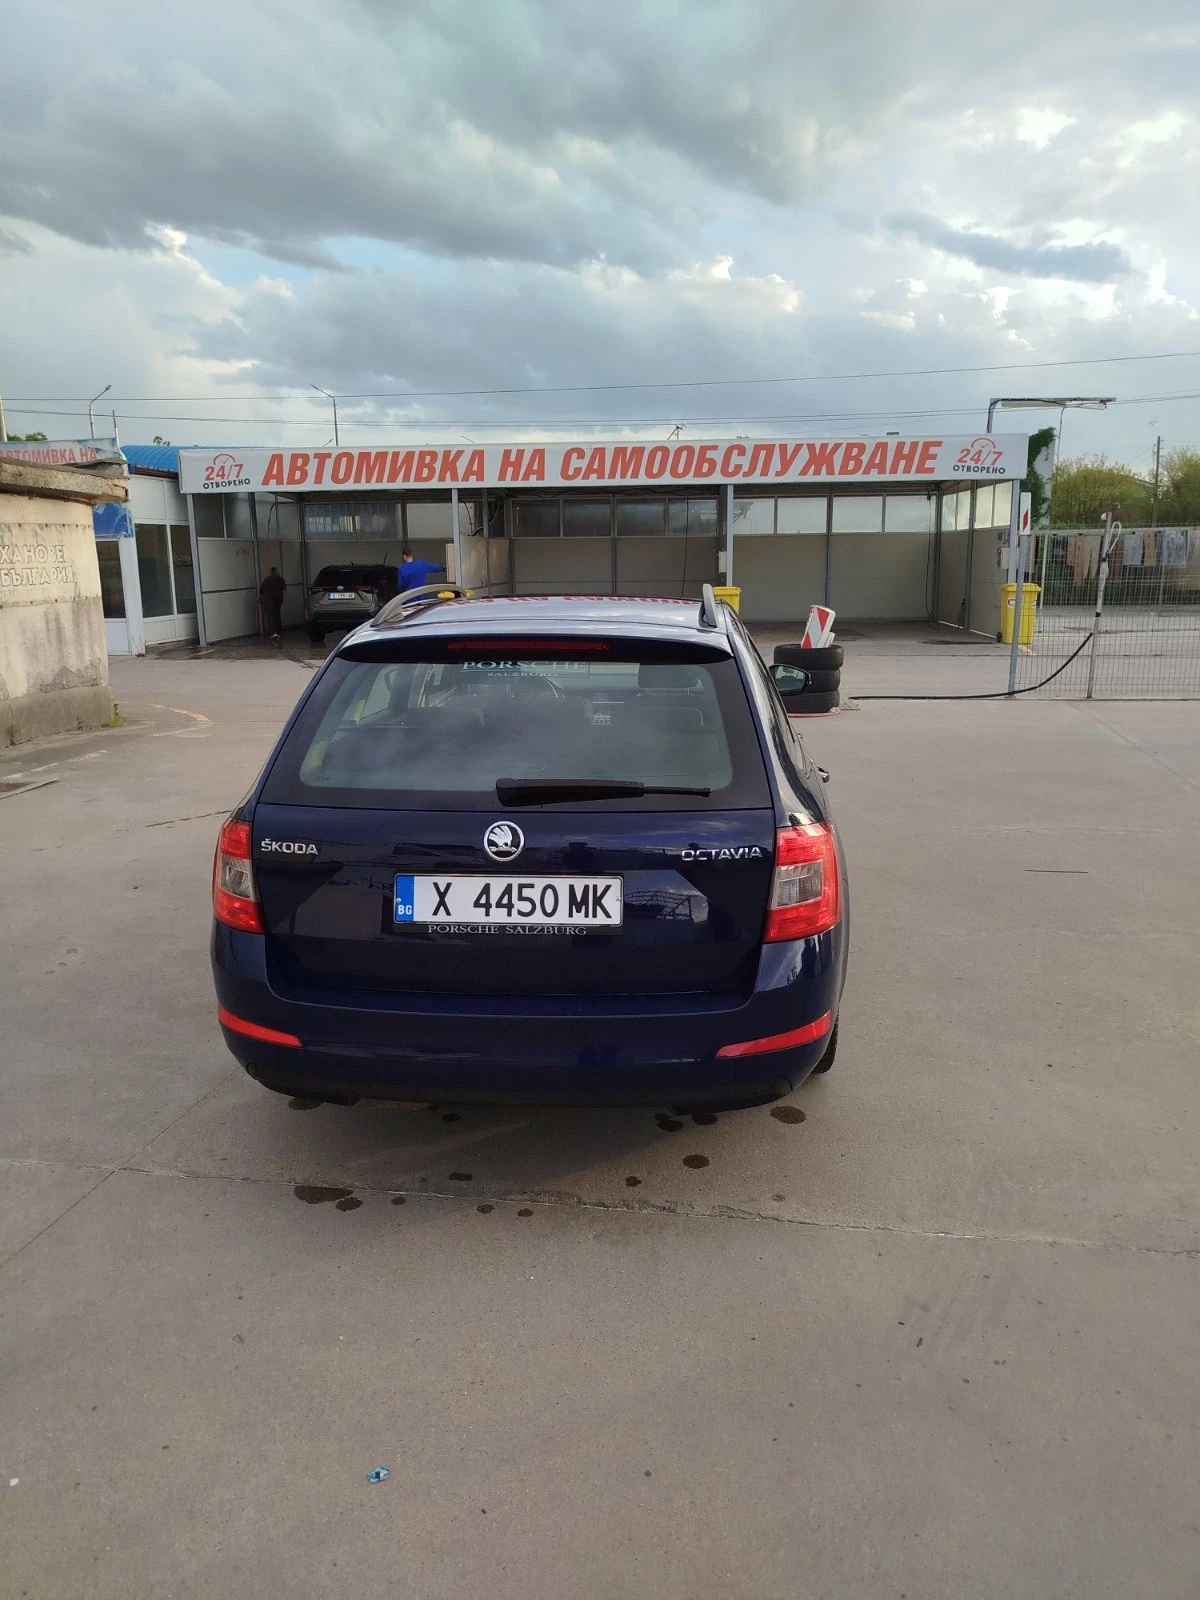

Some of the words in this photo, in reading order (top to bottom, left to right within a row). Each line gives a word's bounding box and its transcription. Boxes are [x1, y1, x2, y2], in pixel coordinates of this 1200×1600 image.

[80, 447, 97, 462] НА
[957, 448, 1003, 466] 24/7
[261, 449, 485, 487] АВТОМИВКА
[497, 448, 545, 482] НА
[560, 440, 943, 481] САМООБСЛУЖВАНЕ
[952, 464, 1006, 475] ОТВОРЕНО
[205, 463, 244, 481] 24/7
[203, 477, 251, 490] ОТВОРЕНО
[462, 660, 587, 670] PORSCHE
[261, 838, 319, 855] ŠKODA
[681, 846, 763, 861] OCTAVIA
[432, 882, 452, 916] X
[473, 883, 560, 918] 4450
[568, 884, 612, 919] MK
[398, 904, 413, 915] BG
[427, 924, 499, 934] PORSCHE
[505, 925, 587, 936] SALZBURG
